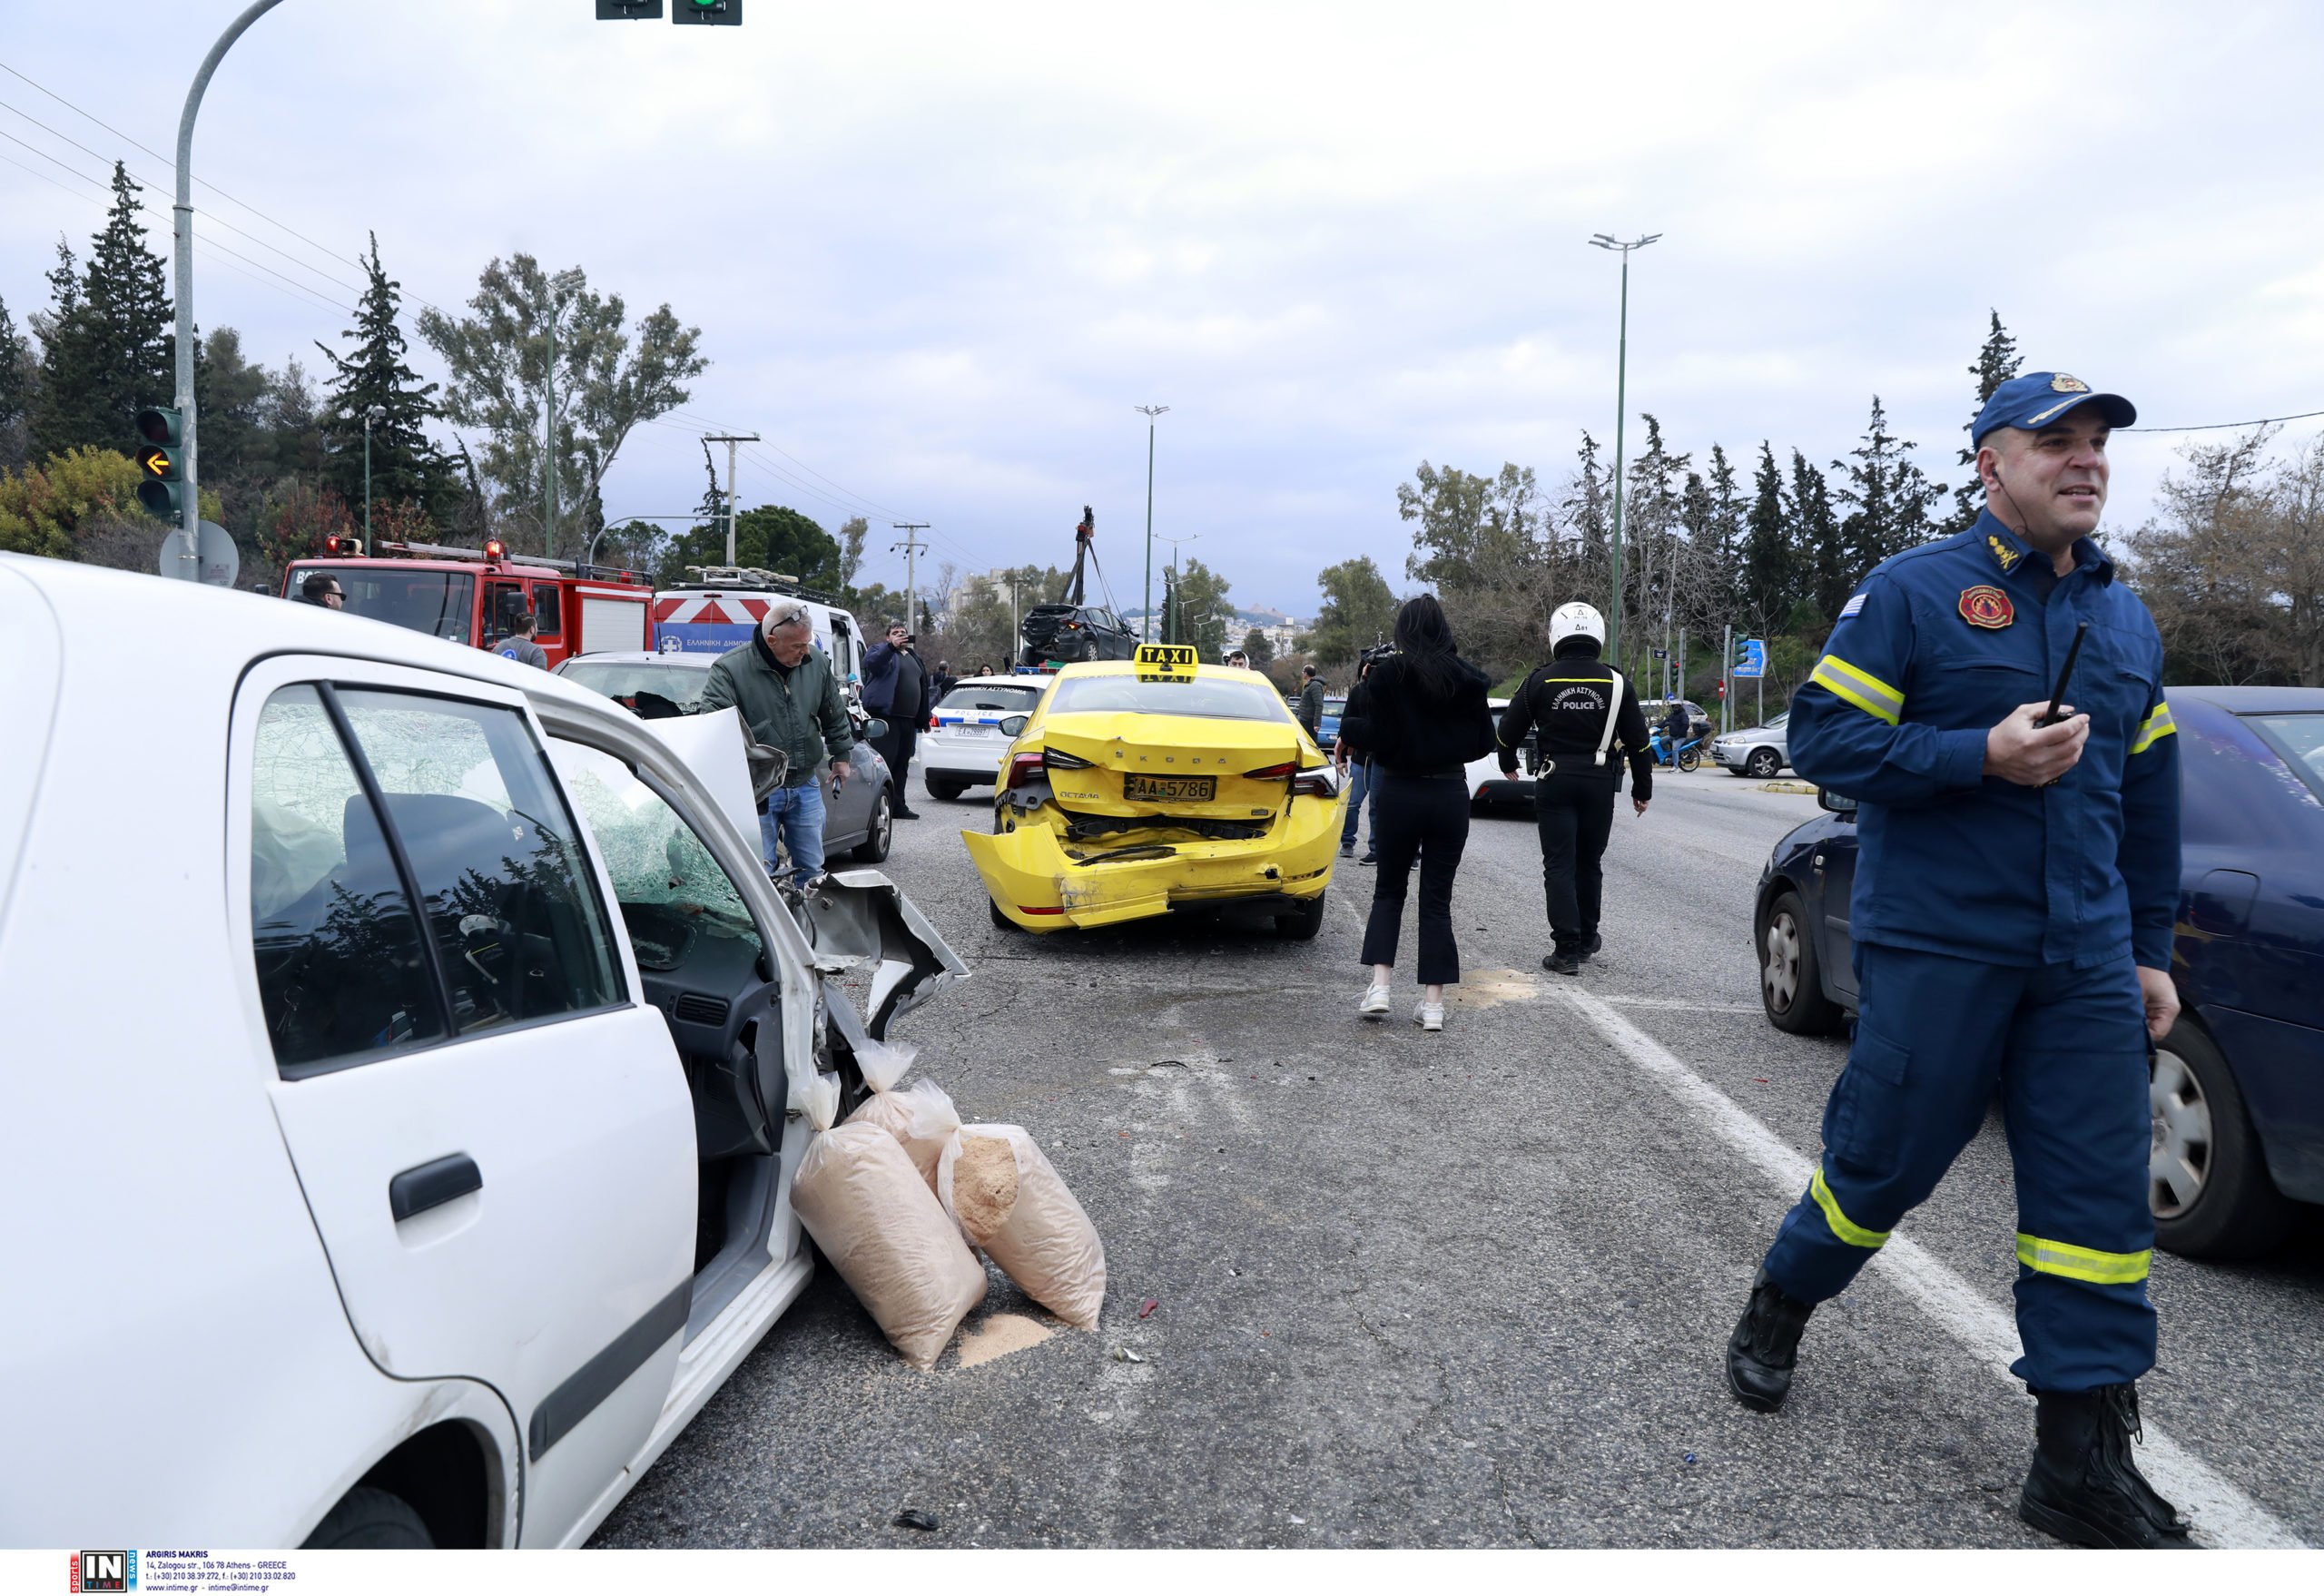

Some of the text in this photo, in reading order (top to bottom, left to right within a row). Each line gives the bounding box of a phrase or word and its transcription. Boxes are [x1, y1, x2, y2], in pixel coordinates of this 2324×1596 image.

[1145, 648, 1189, 664] TAXI
[1551, 686, 1606, 710] ΕΛΛΗΝΙΚΗ ΑΣΤΥΝΟΜΙΑ
[1562, 702, 1595, 710] POLICE
